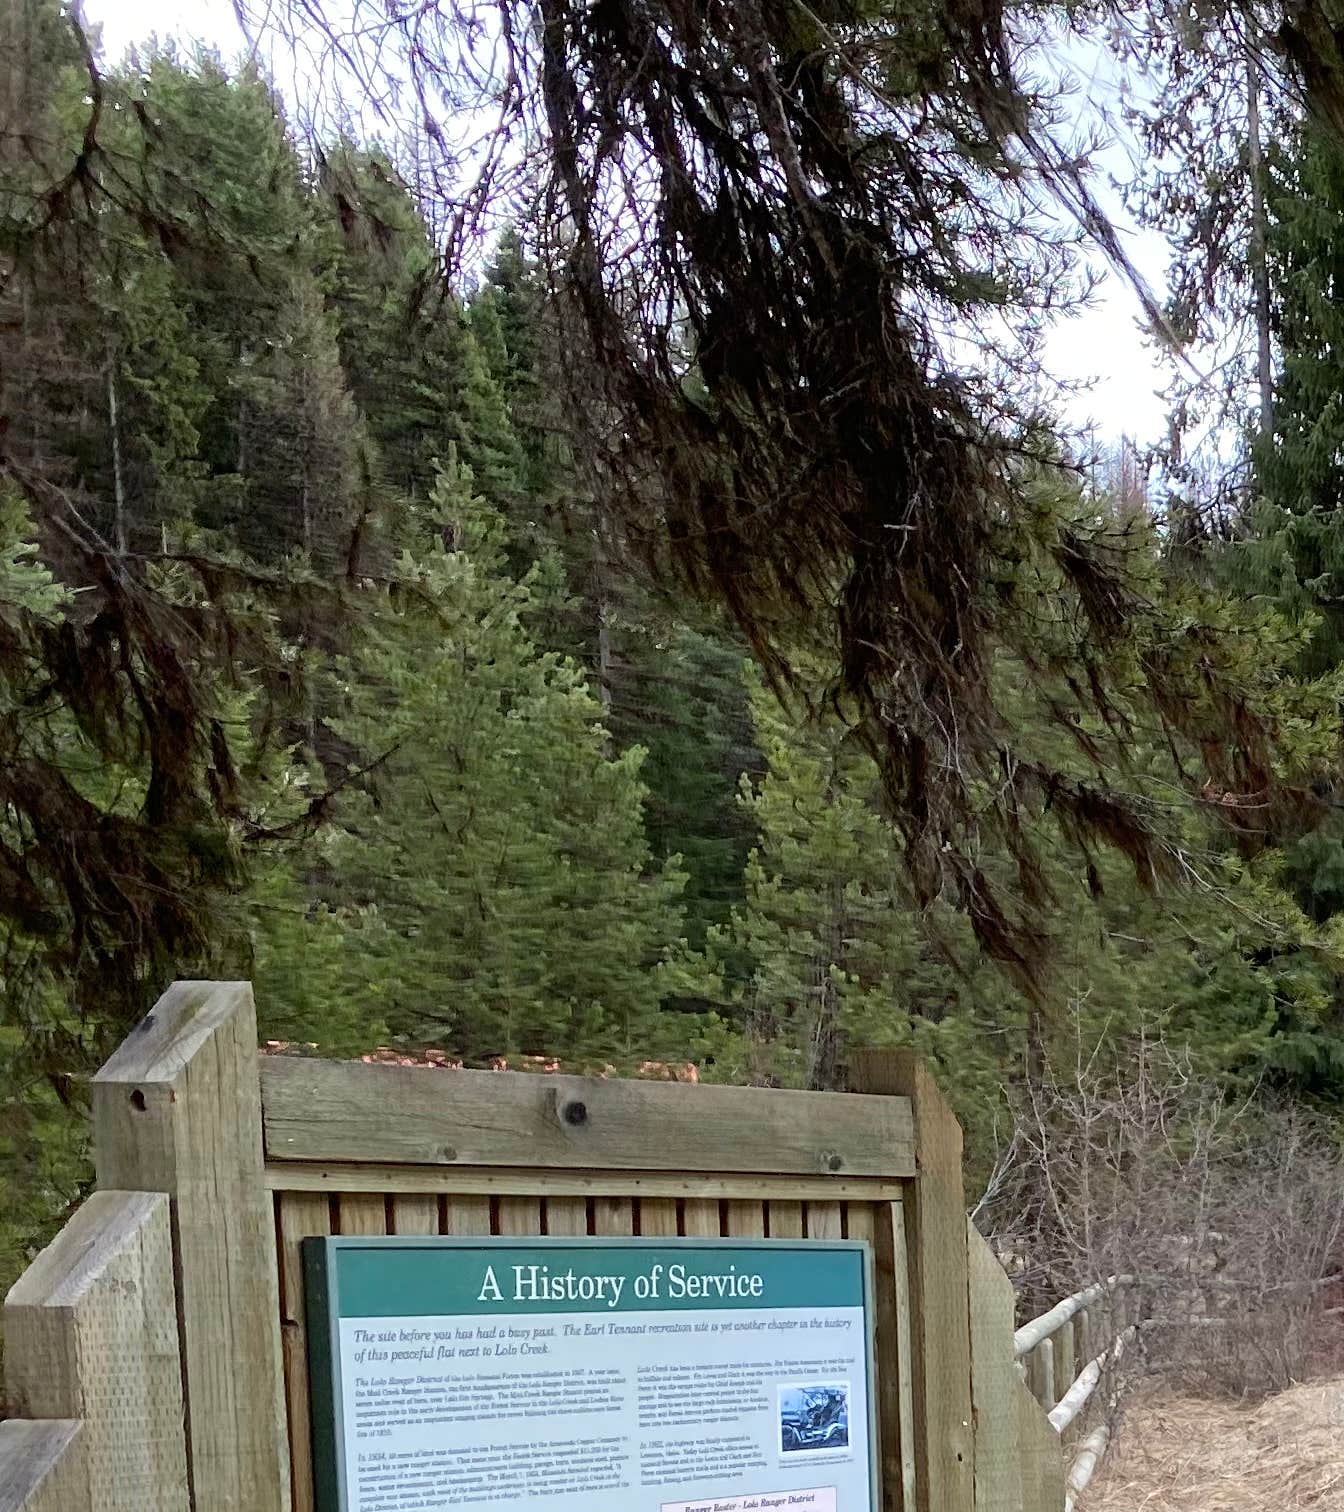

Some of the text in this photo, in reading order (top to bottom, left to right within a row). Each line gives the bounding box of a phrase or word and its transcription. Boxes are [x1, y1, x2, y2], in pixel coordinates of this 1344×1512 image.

[476, 1265, 763, 1308] A History of Service
[354, 1330, 374, 1342] The
[378, 1331, 396, 1341] site
[399, 1328, 430, 1343] before
[433, 1332, 450, 1341] you
[456, 1327, 472, 1338] has
[476, 1327, 495, 1338] had
[508, 1326, 530, 1339] busy
[563, 1324, 581, 1335] The
[583, 1324, 604, 1334] Earl
[608, 1323, 645, 1334] Tennant
[649, 1323, 690, 1332] recreation
[694, 1323, 708, 1331] site
[711, 1322, 717, 1330] is
[721, 1323, 731, 1332] yet
[734, 1320, 765, 1330] another
[768, 1319, 797, 1331] chapter
[800, 1320, 807, 1328] in
[810, 1318, 822, 1327] the
[824, 1318, 851, 1329] history
[354, 1349, 365, 1363] of
[368, 1349, 387, 1360] this
[391, 1347, 433, 1361] peaceful
[437, 1346, 454, 1359] flat
[458, 1346, 479, 1357] next
[482, 1346, 491, 1356] to
[495, 1344, 516, 1355] Lolo
[760, 1496, 785, 1507] Ranger
[788, 1493, 814, 1503] District
